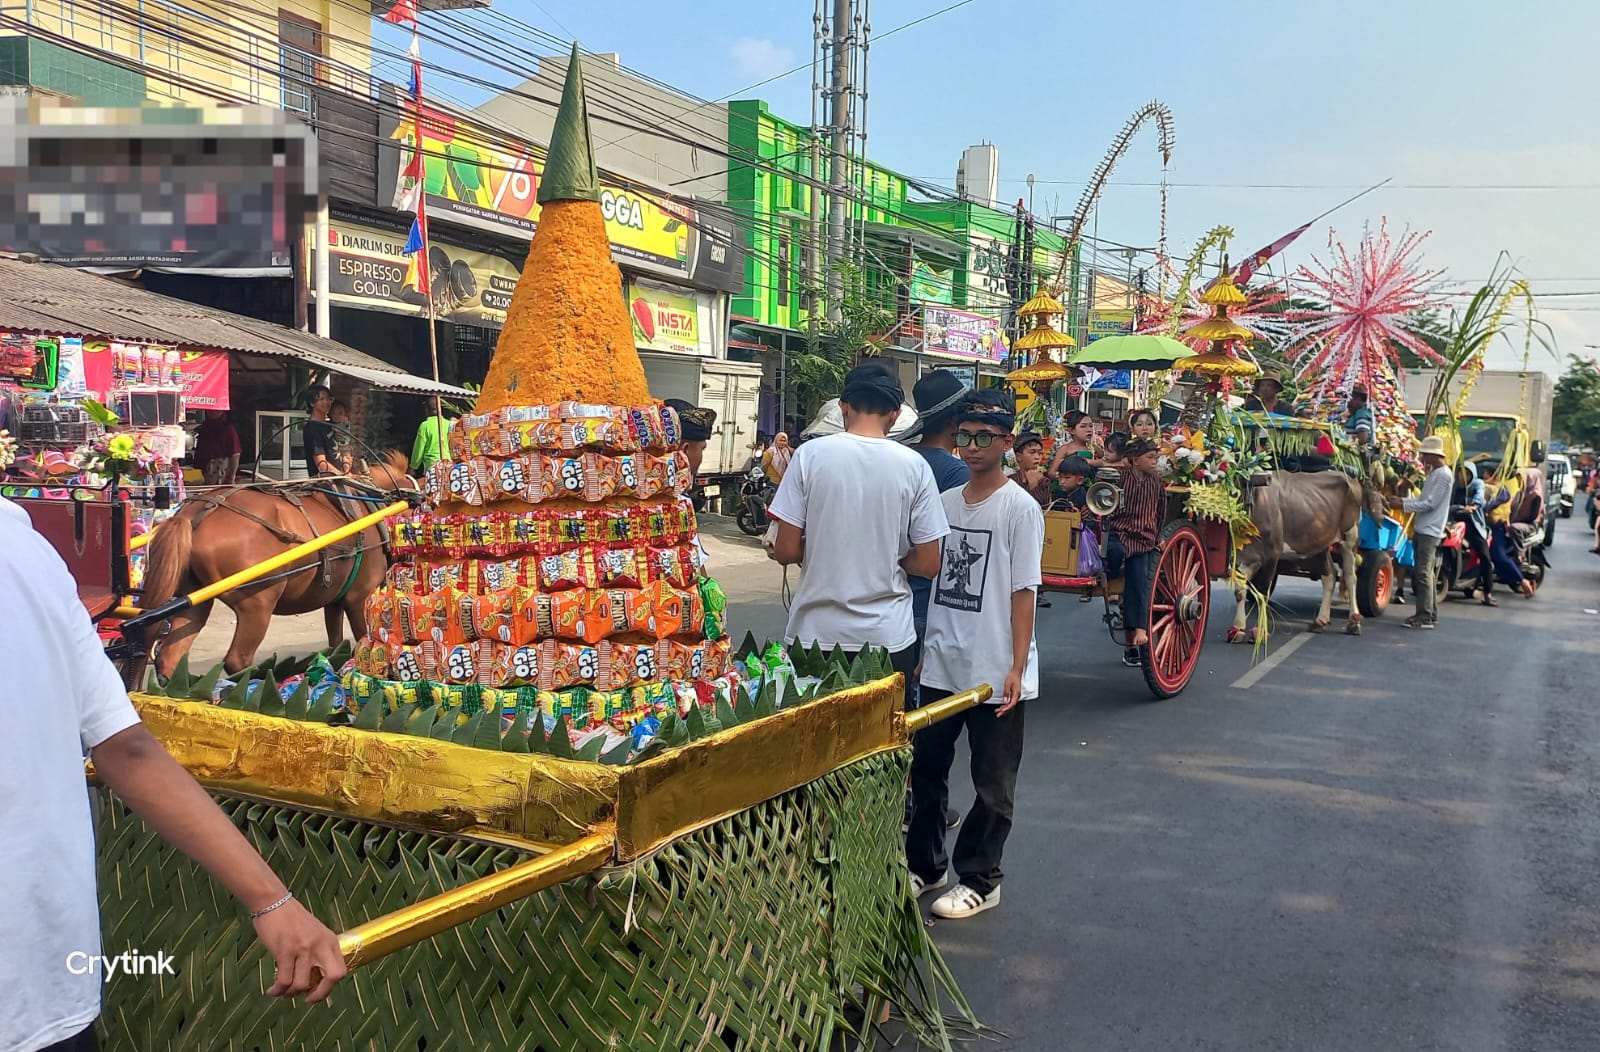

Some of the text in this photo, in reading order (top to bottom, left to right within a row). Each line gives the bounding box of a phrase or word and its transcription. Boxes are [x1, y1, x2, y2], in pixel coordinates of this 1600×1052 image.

[342, 234, 383, 254] DJARUM
[339, 258, 402, 283] ESPRESSO
[353, 280, 391, 297] GOLD
[658, 310, 693, 332] INSTA
[449, 468, 462, 493] GO
[460, 465, 471, 491] RING
[500, 466, 516, 491] GO
[511, 463, 525, 490] RING
[561, 465, 578, 490] GO
[573, 461, 585, 488] RING
[621, 463, 634, 487] GO
[535, 592, 554, 638] CRUNCHY
[609, 589, 629, 632] CRUNCHY
[397, 656, 411, 681] GO
[406, 653, 421, 680] RING
[449, 653, 465, 679] GO
[461, 649, 475, 677] RING
[513, 652, 529, 678] GO
[527, 648, 539, 676] RING
[578, 653, 593, 678] GO
[635, 653, 650, 678] GO
[646, 649, 656, 676] RING
